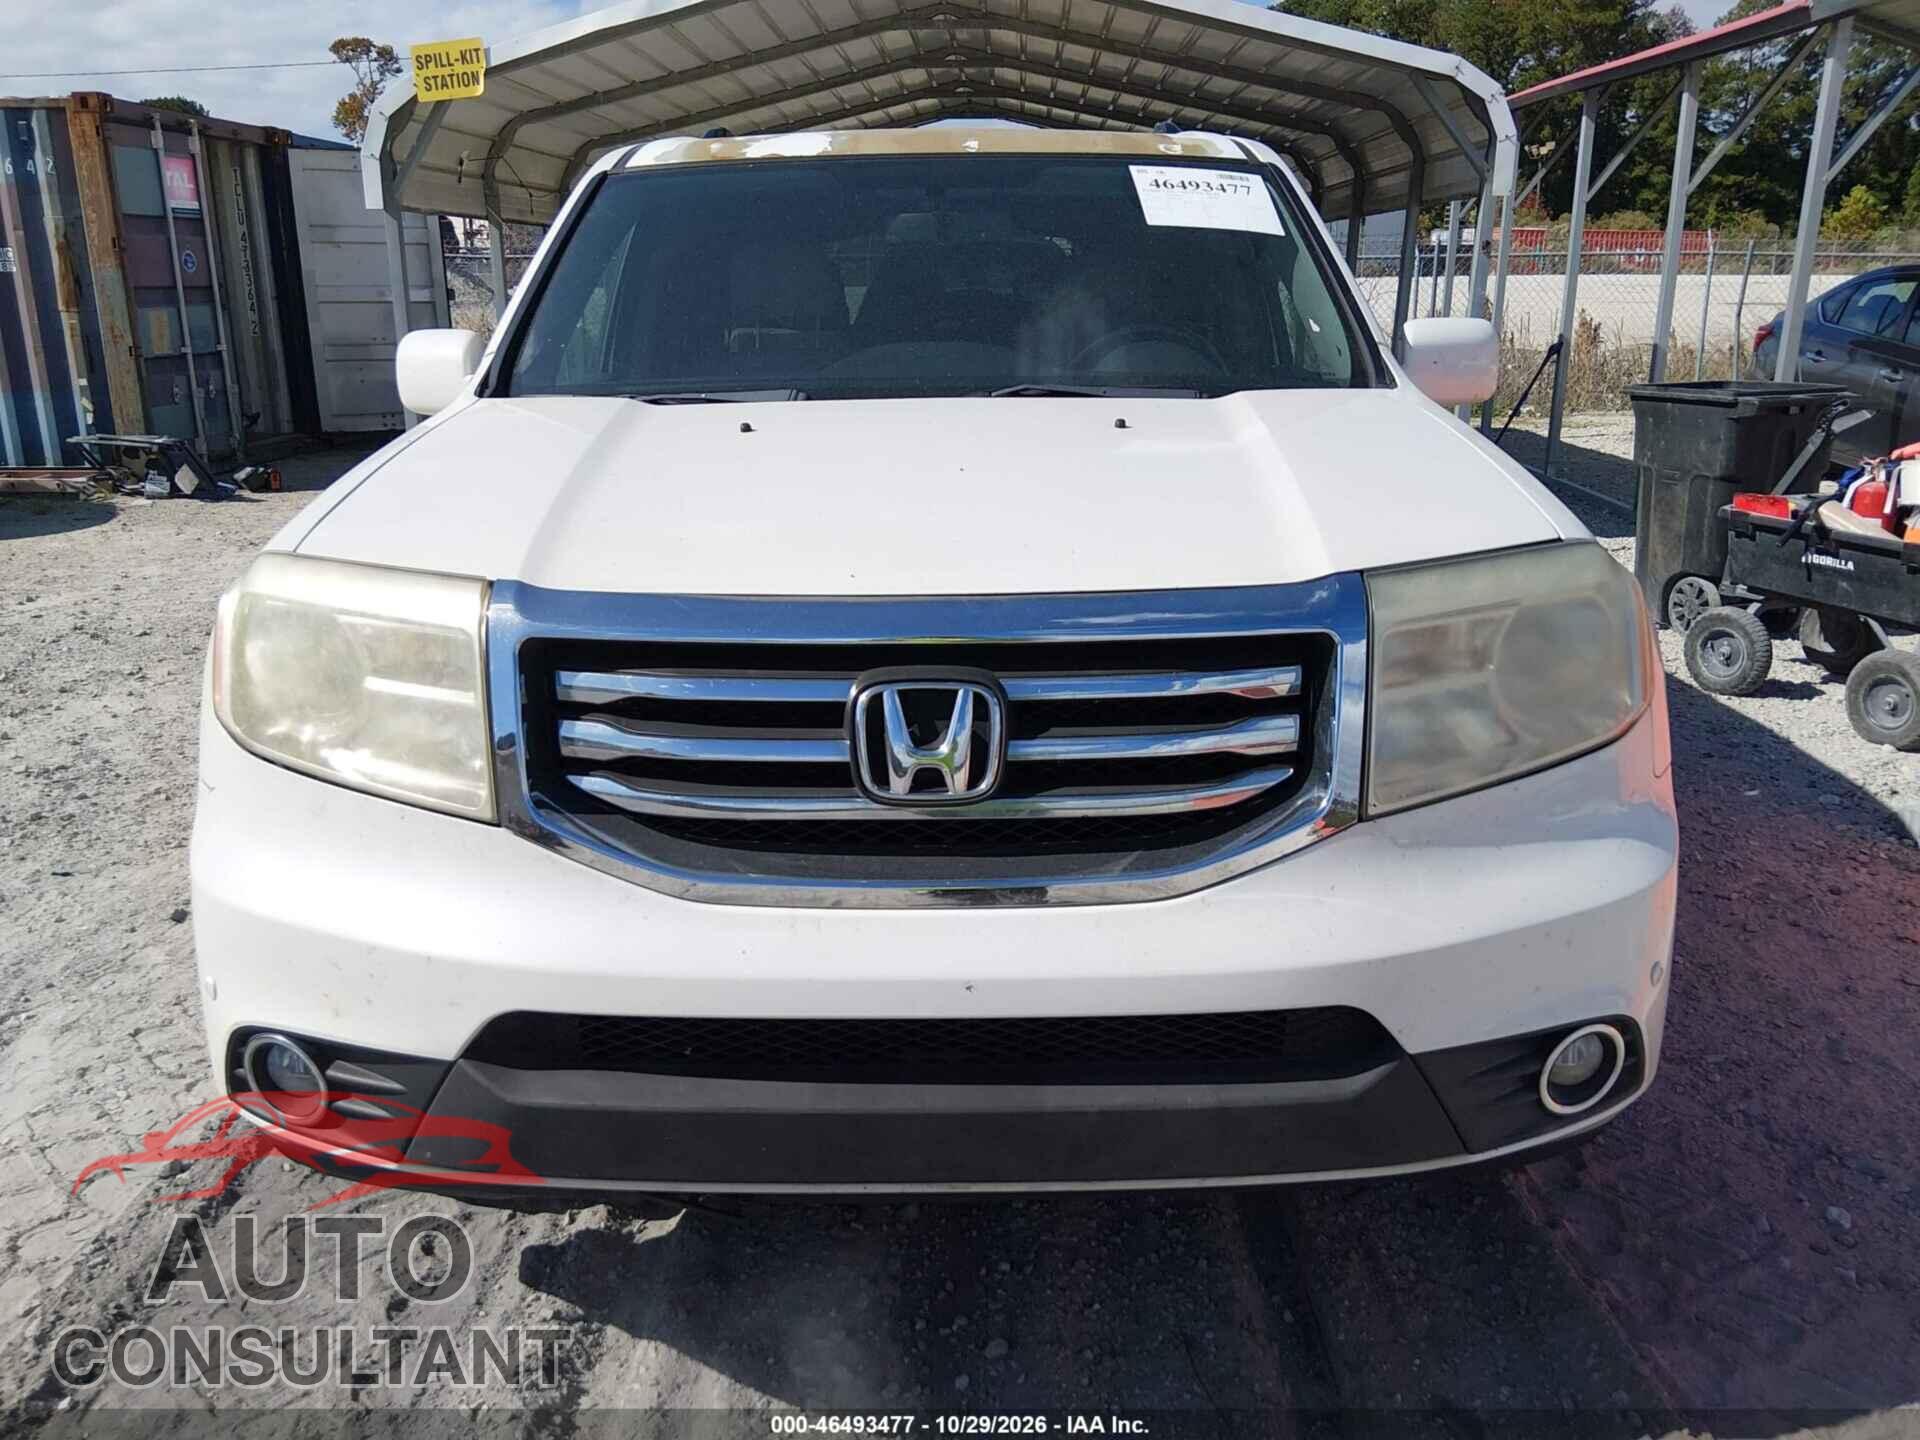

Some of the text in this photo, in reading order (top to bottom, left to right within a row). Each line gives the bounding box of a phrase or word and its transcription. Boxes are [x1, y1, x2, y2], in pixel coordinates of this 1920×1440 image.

[415, 47, 481, 71] SPILL-KIT
[423, 70, 481, 92] STATION
[1149, 178, 1251, 196] 46493477
[1812, 554, 1854, 571] GORILLA
